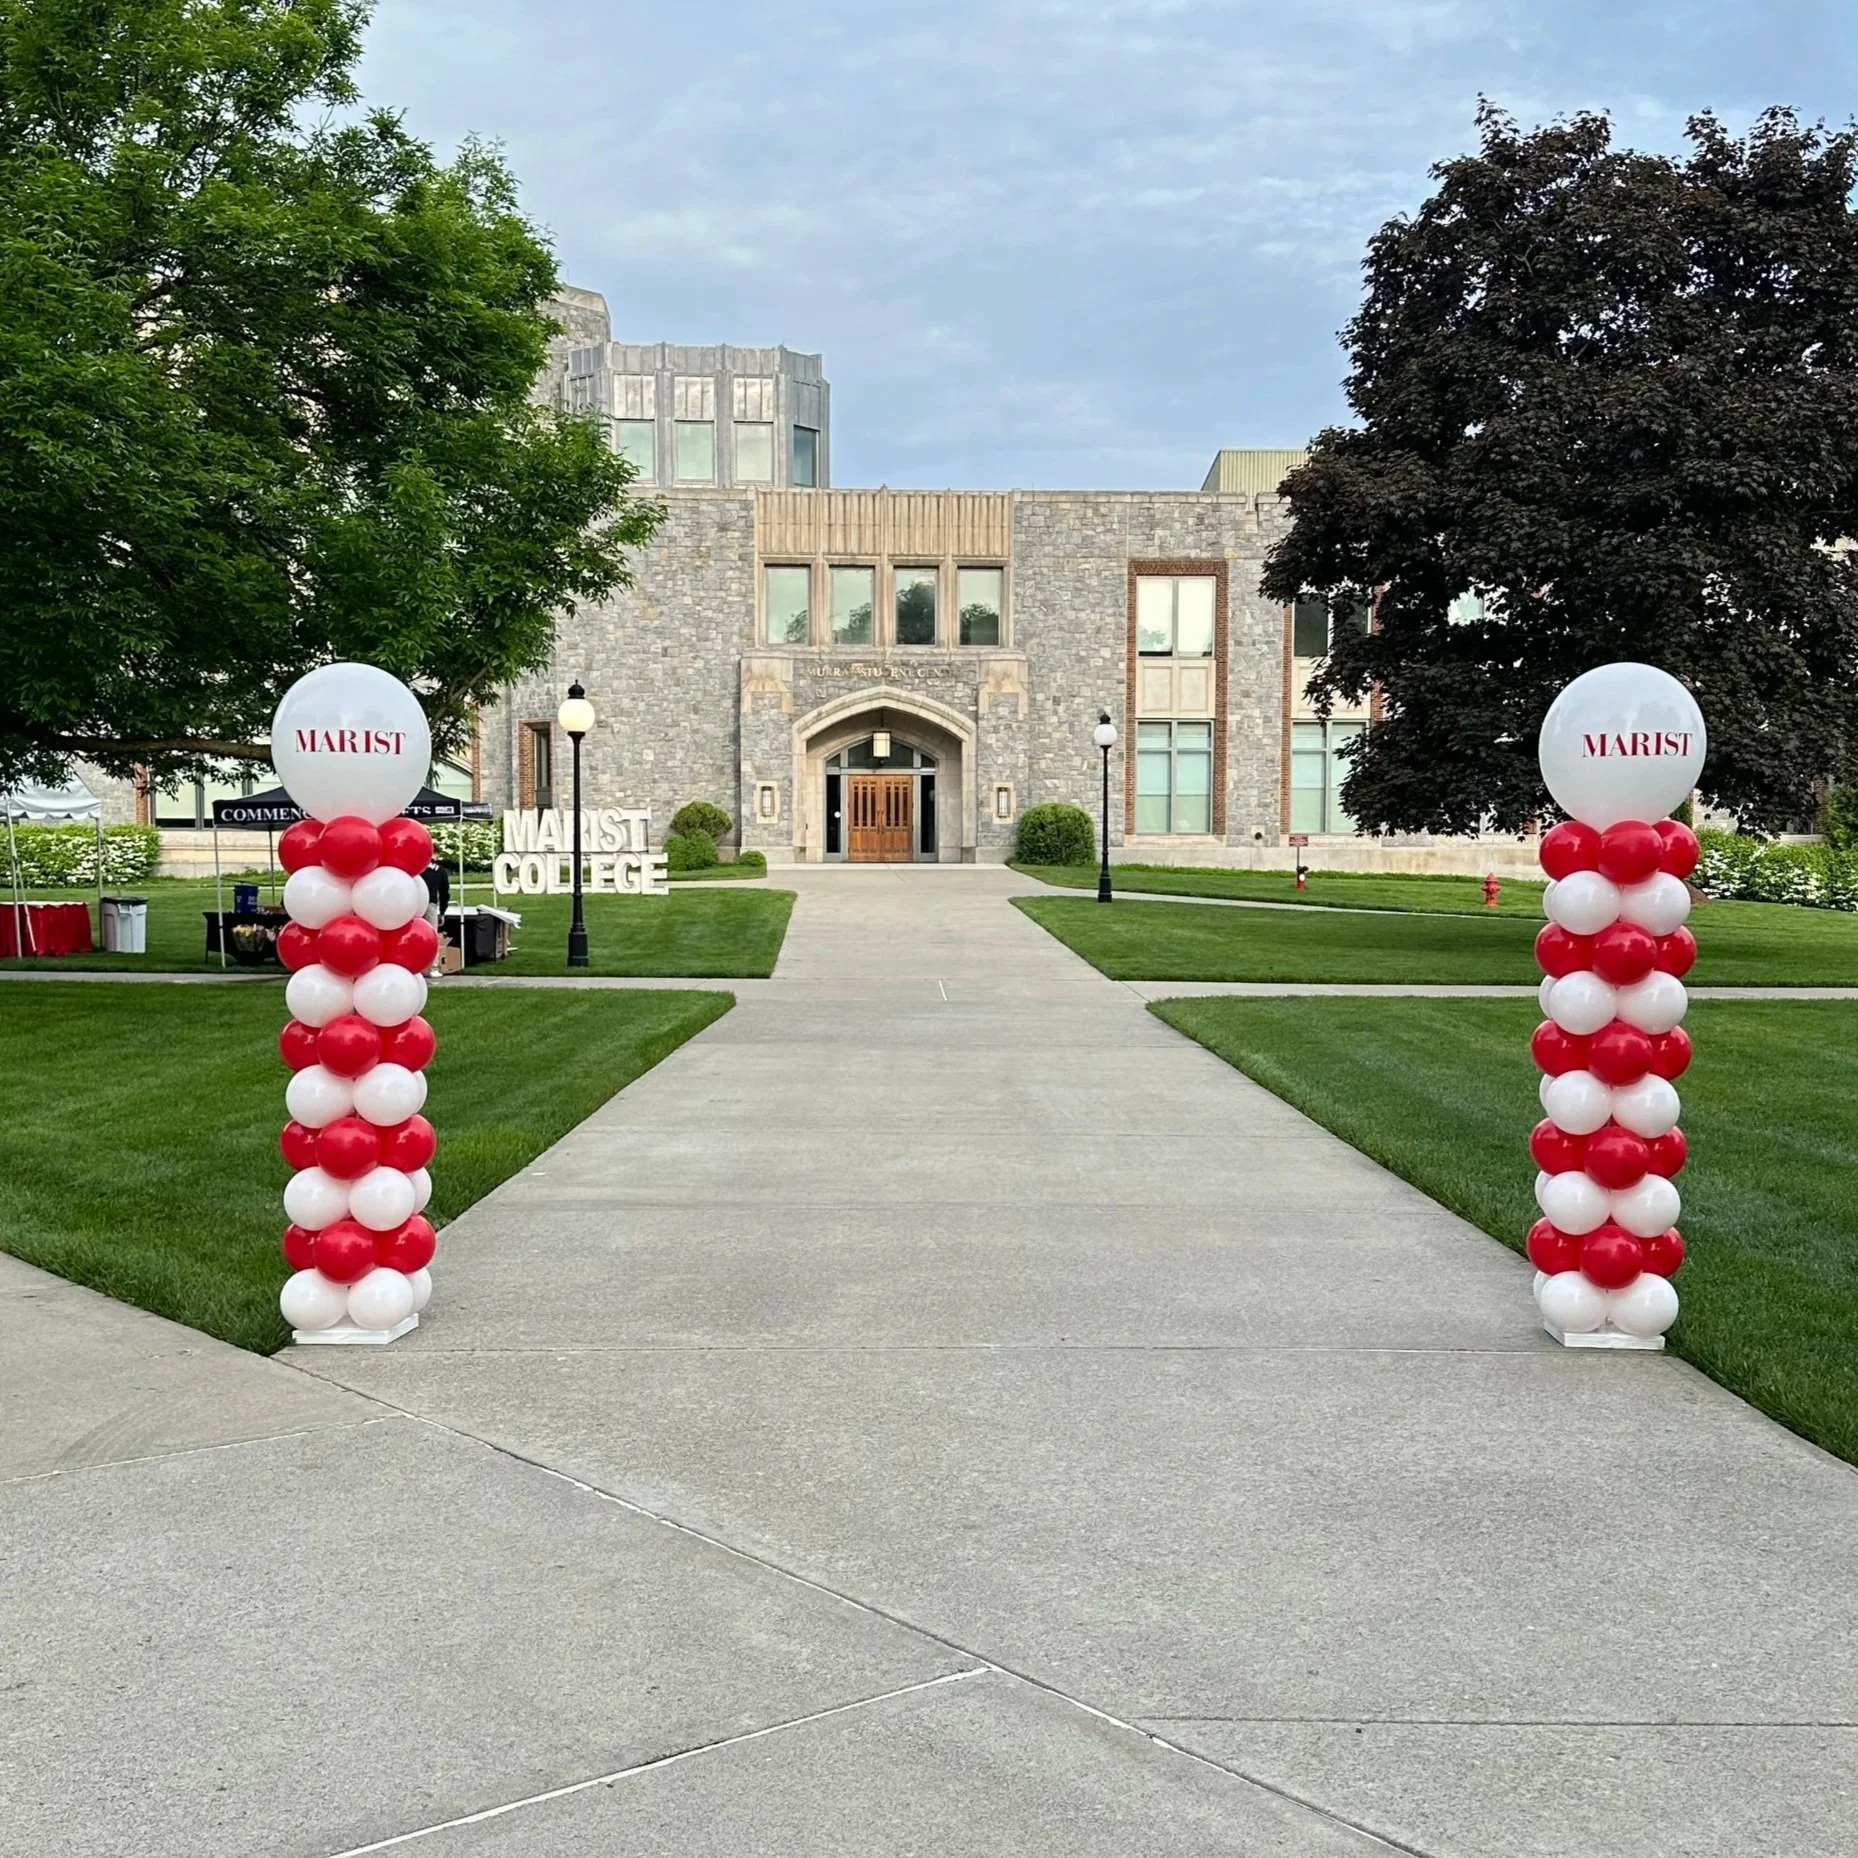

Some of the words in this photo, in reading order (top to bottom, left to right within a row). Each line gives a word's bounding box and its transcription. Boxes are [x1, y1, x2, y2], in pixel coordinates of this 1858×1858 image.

[860, 667, 913, 678] STUENT
[295, 729, 406, 755] MARIST
[1582, 732, 1693, 757] MARIST
[503, 807, 652, 852] MARIST
[494, 852, 669, 895] COLLEGE
